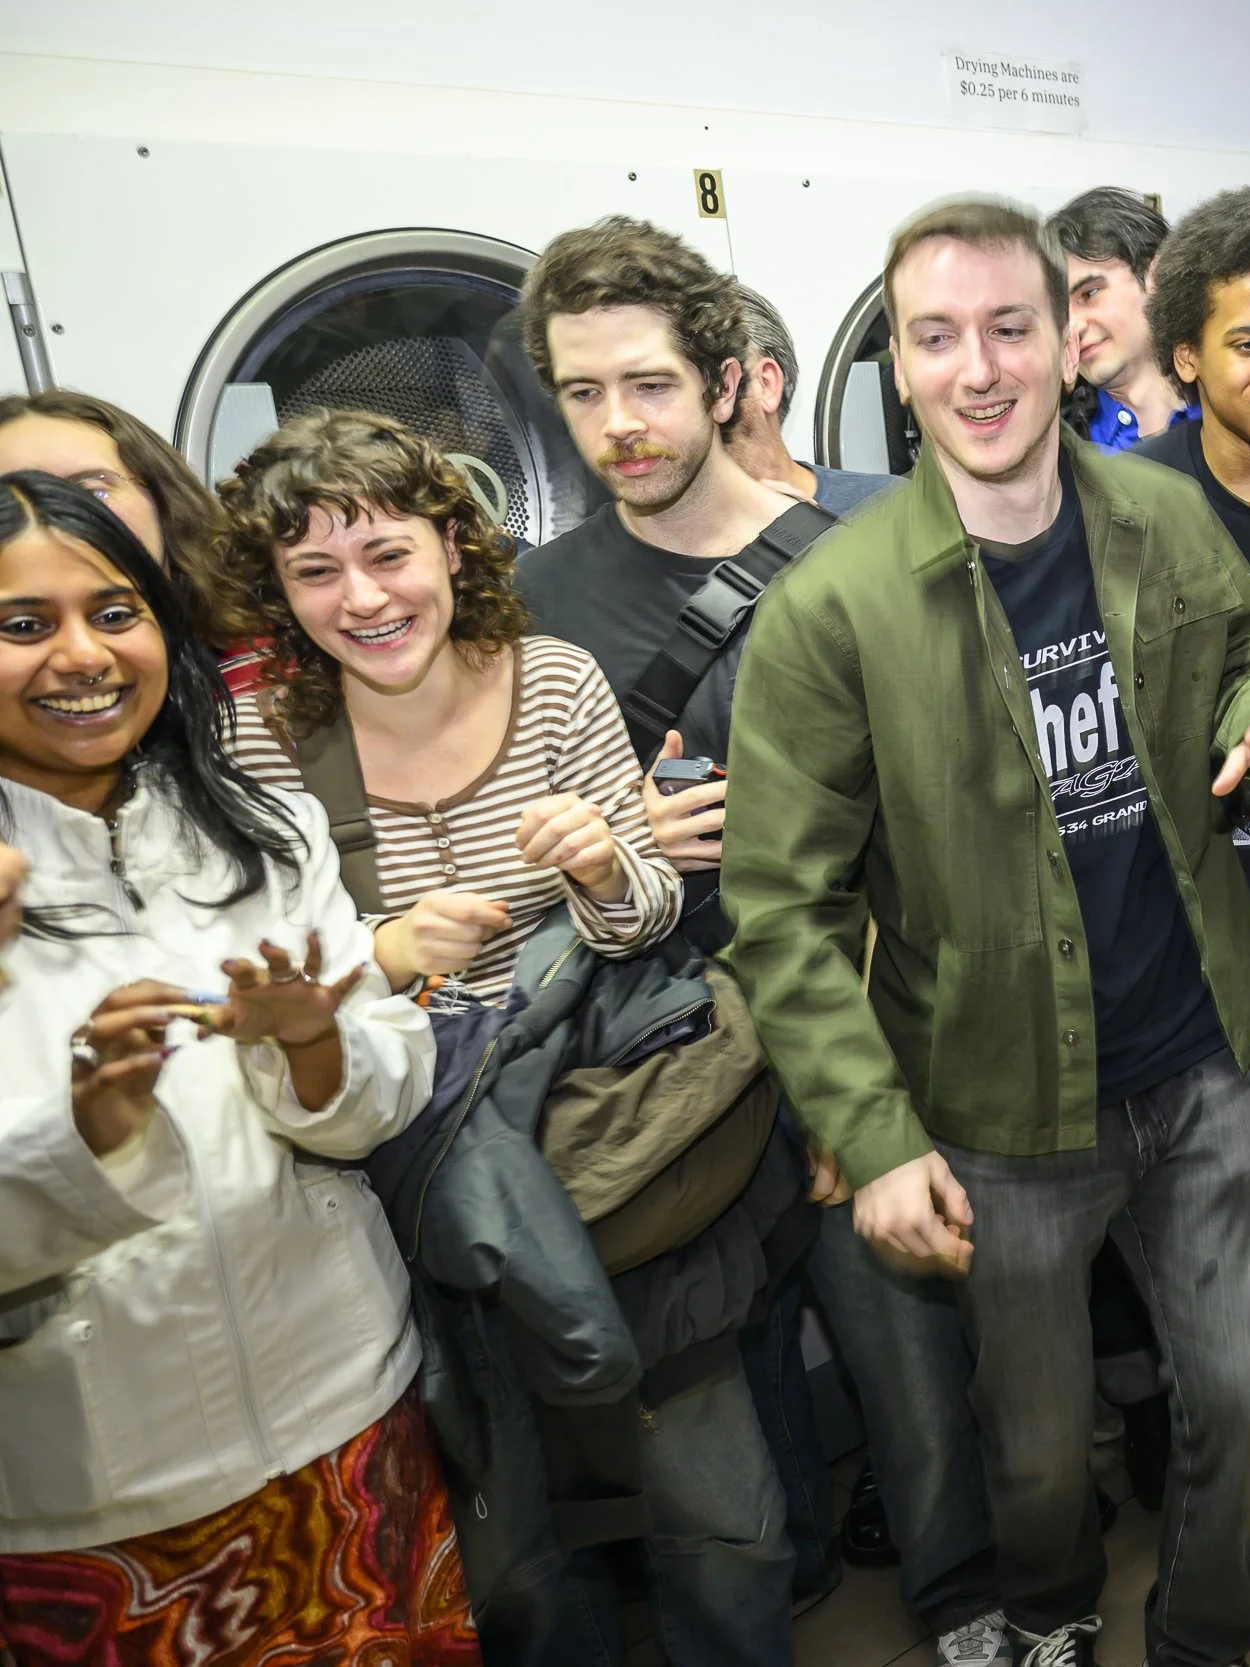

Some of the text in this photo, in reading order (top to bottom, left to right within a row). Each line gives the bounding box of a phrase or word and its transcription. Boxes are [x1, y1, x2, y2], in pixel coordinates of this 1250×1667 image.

[955, 56, 1079, 85] Drying Machines are
[960, 80, 1080, 106] $0.25 per 6 minutes
[699, 172, 719, 214] 8
[1020, 630, 1106, 669] URVIV
[1092, 800, 1148, 826] GRAND
